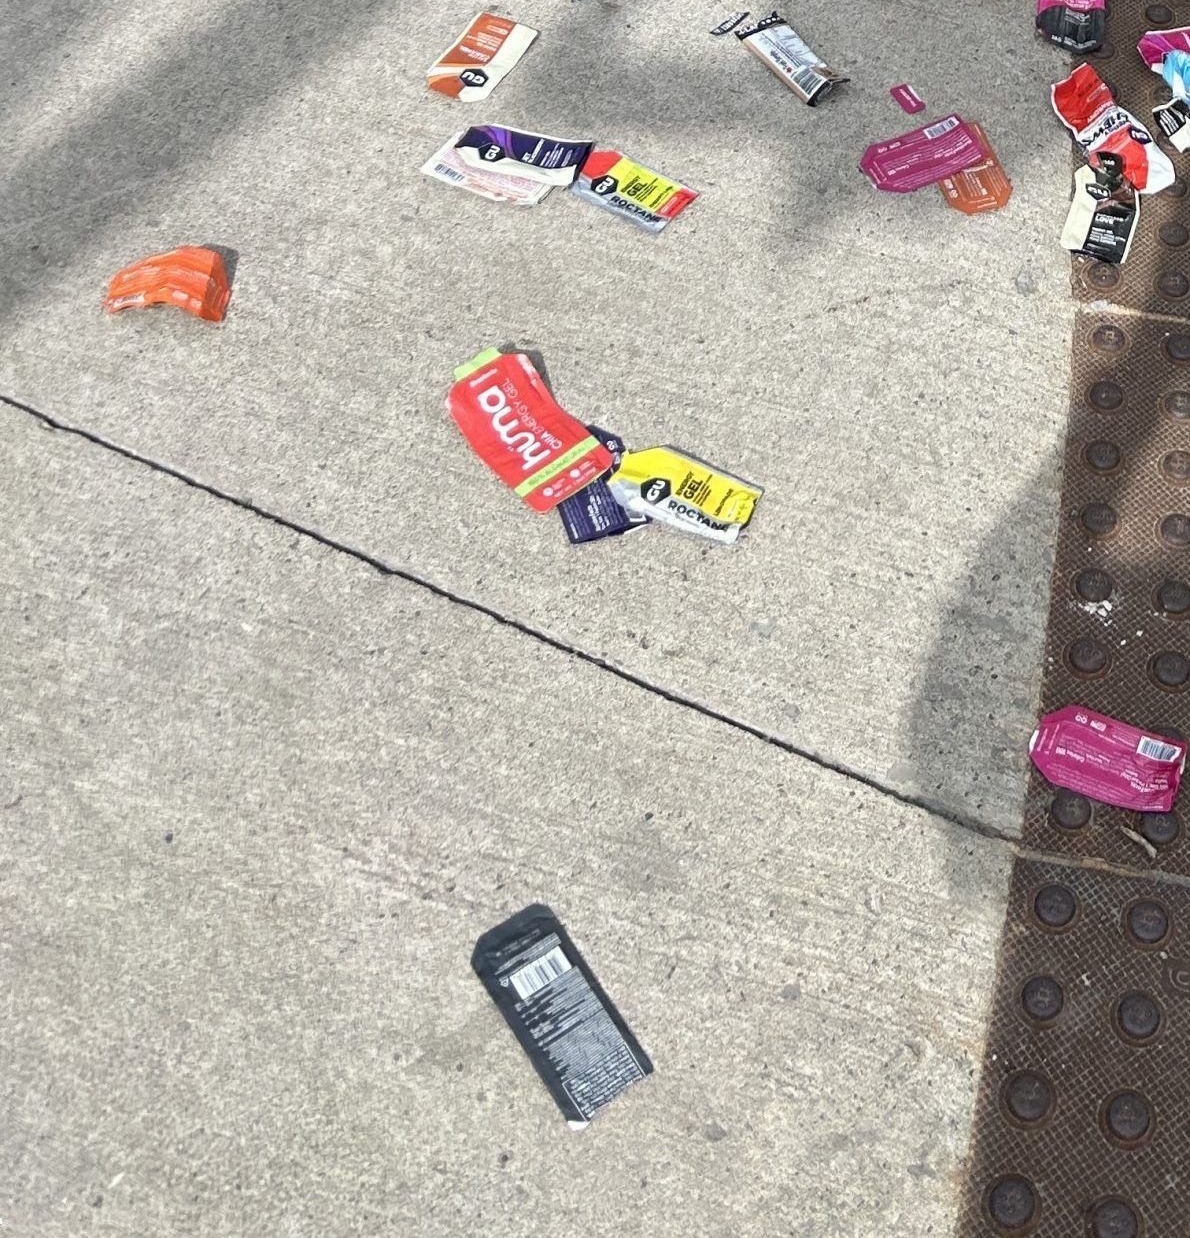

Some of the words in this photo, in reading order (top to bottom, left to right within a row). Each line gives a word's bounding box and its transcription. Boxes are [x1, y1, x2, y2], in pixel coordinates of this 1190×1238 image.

[461, 71, 485, 85] GU
[485, 145, 501, 160] GU
[595, 176, 614, 194] GU
[628, 181, 645, 198] GEL
[611, 194, 662, 223] ROCTANE
[646, 479, 667, 501] GU
[675, 470, 694, 496] ENERGY
[683, 478, 701, 500] GEL
[667, 498, 728, 532] ROCTANE
